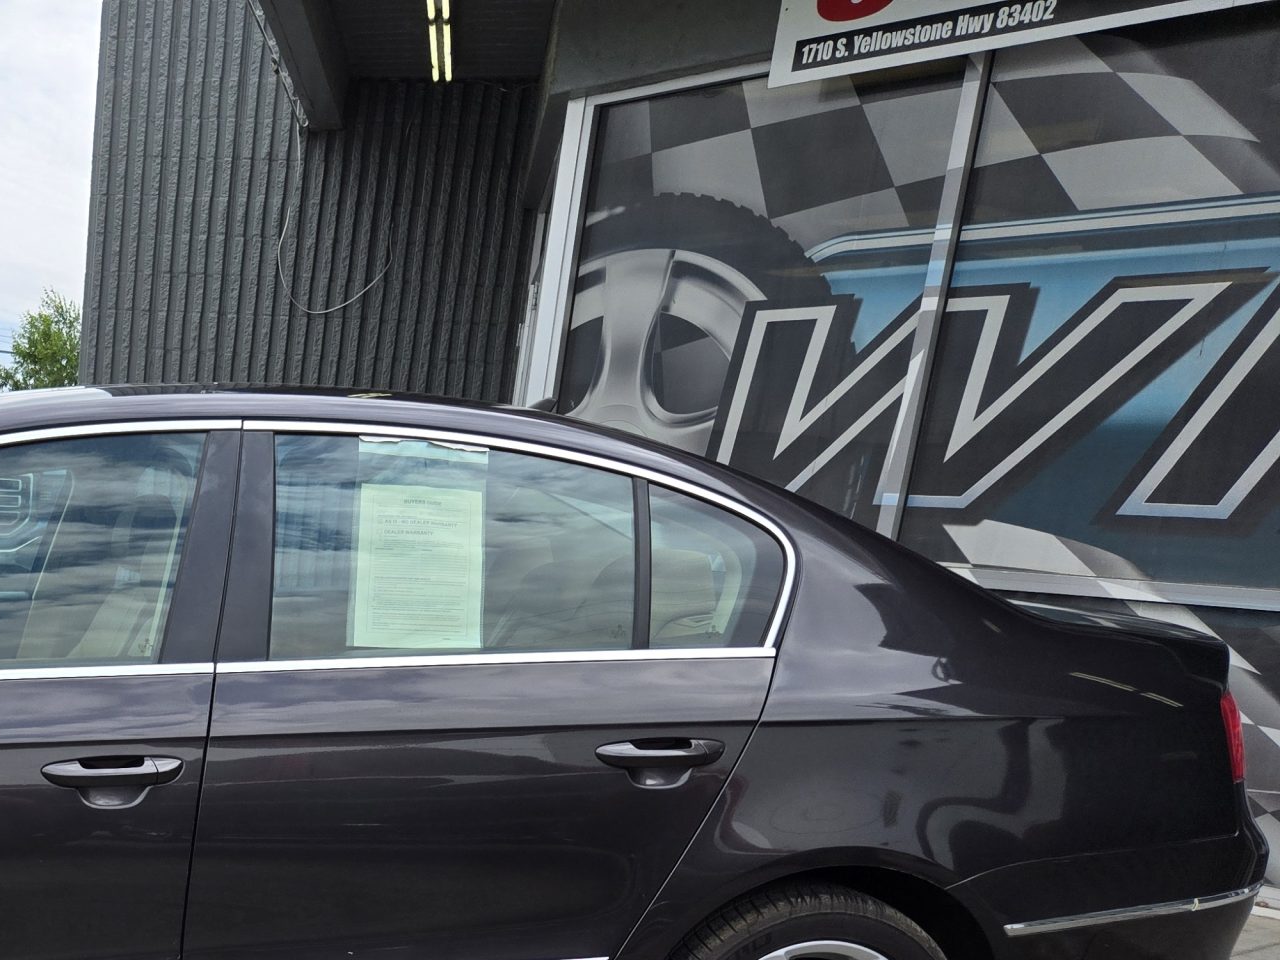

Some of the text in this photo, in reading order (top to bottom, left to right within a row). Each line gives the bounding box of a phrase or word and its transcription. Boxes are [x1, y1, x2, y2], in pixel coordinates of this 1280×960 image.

[801, 0, 1058, 65] 1710 S. Yellowstone Hwy 83402
